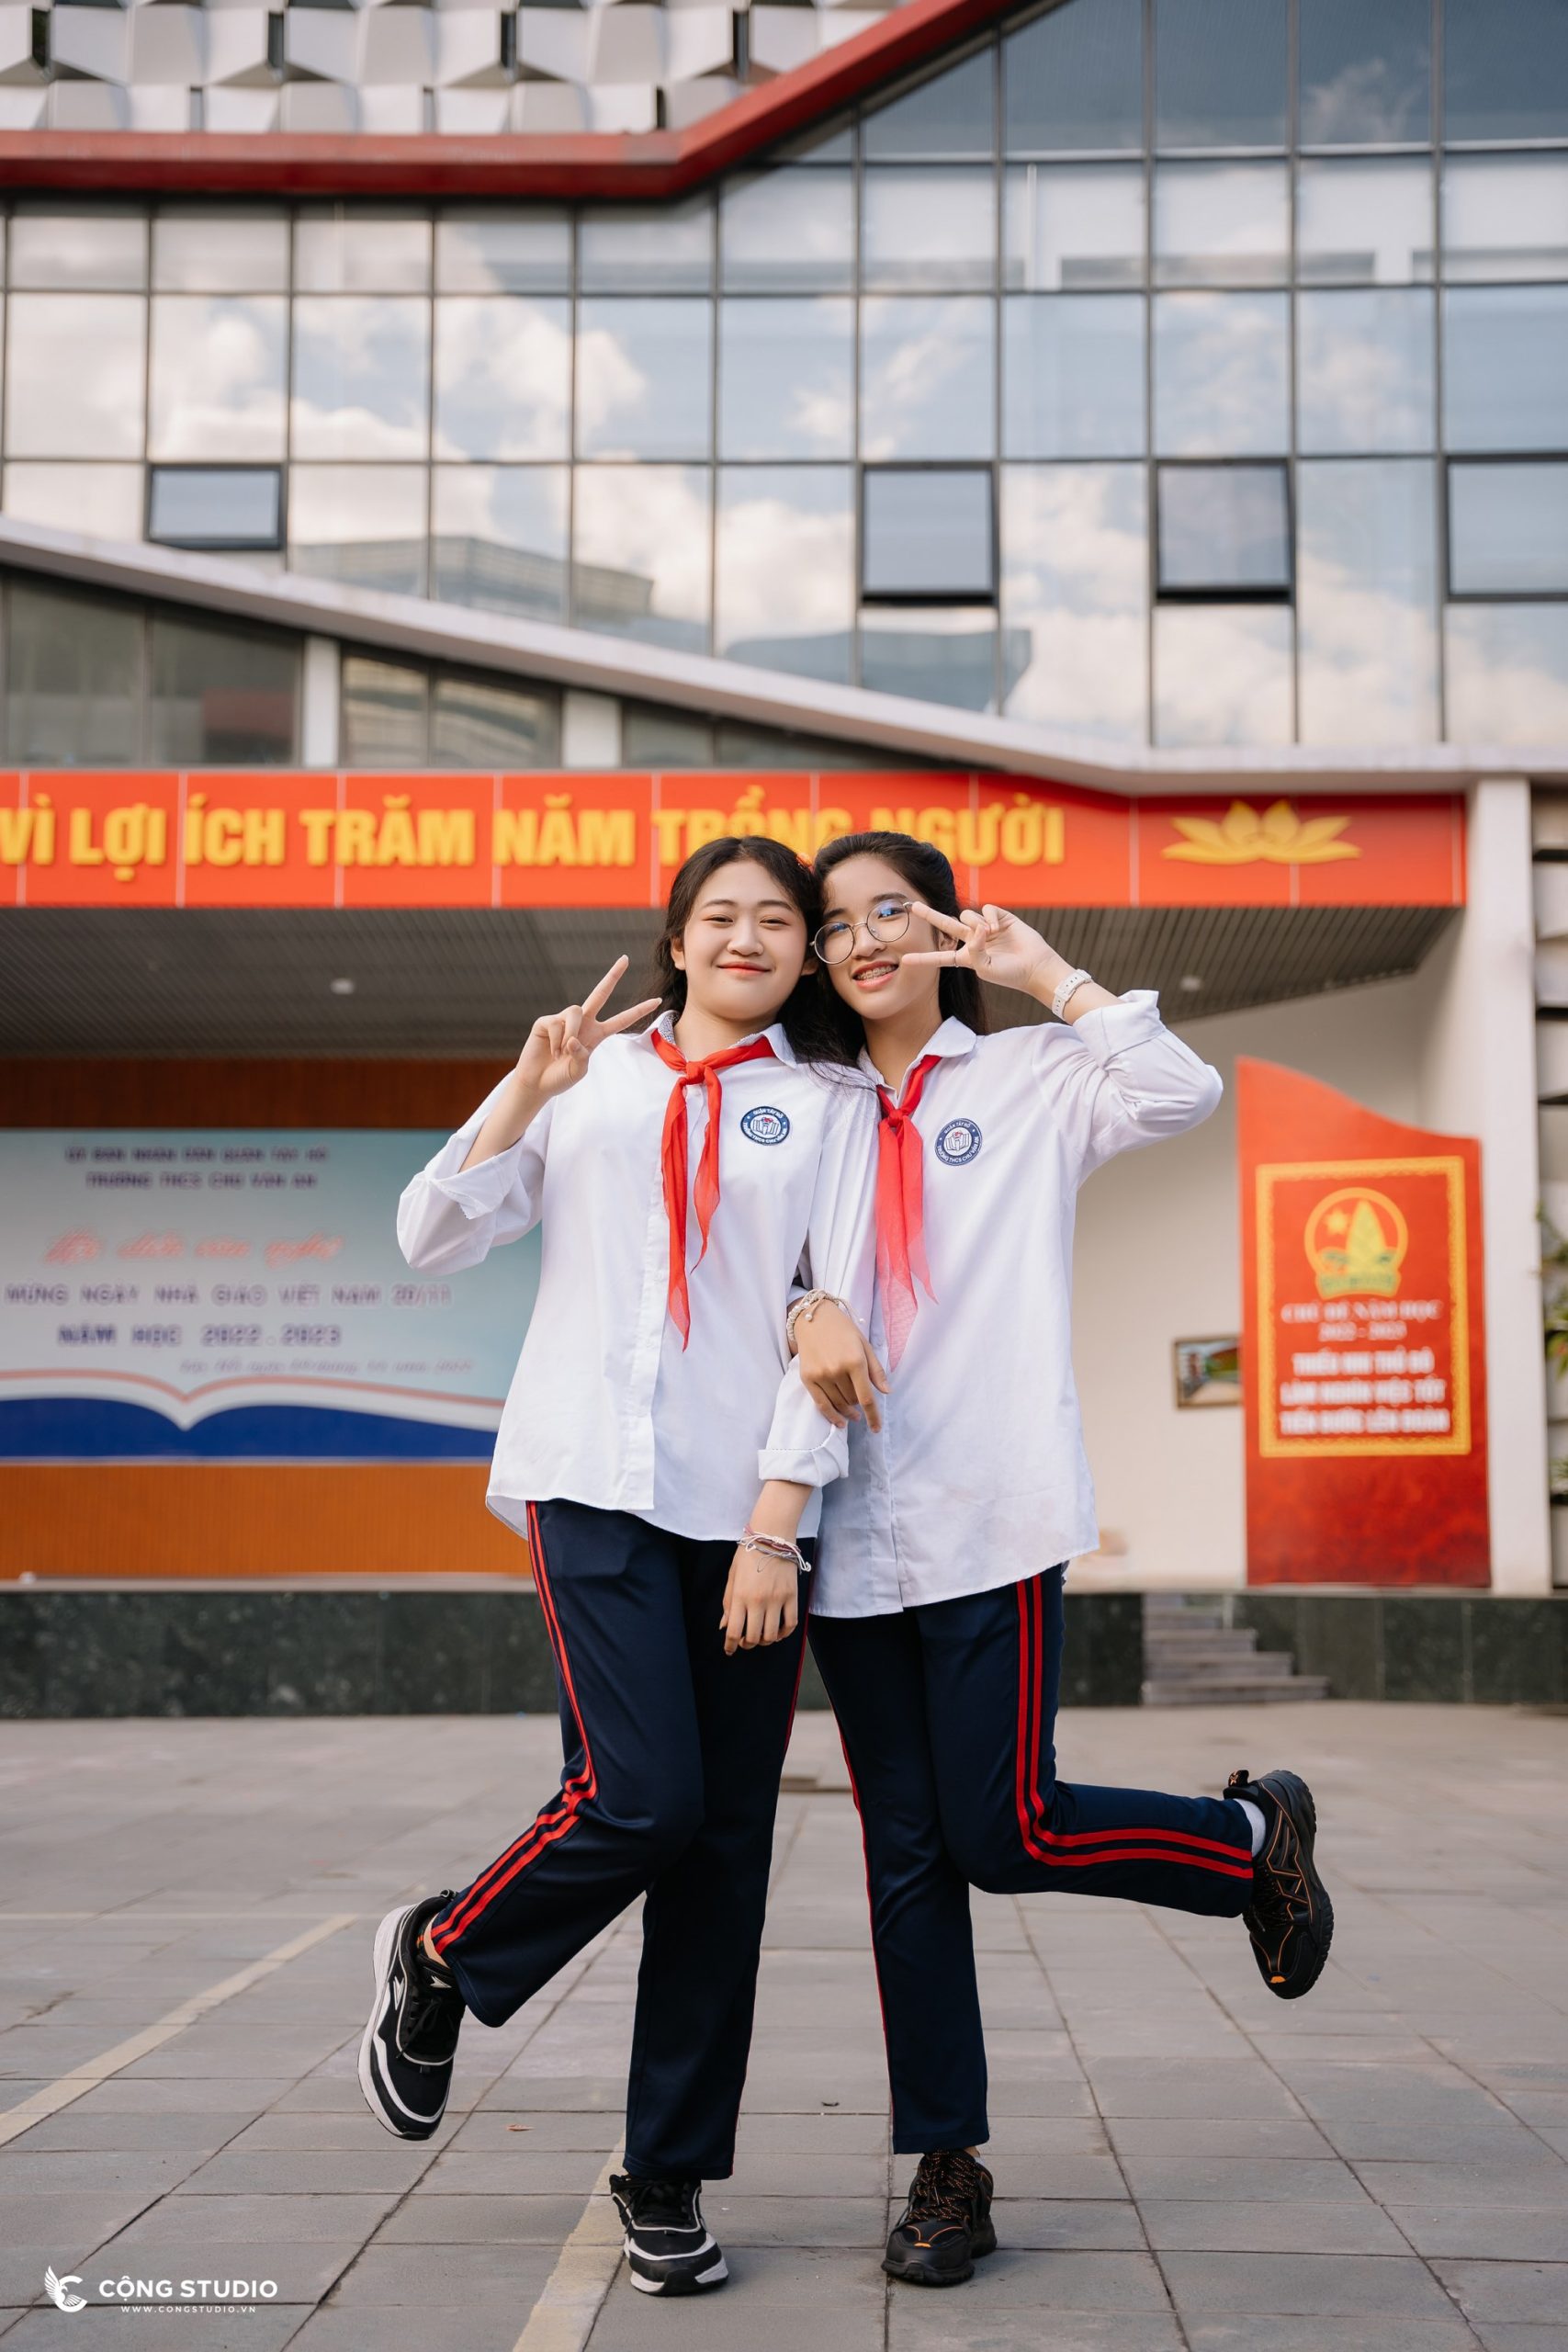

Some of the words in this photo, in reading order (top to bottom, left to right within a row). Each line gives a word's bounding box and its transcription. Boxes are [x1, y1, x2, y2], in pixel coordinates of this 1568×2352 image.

[0, 792, 55, 865] VÌ
[69, 802, 167, 883] LỢI
[184, 792, 286, 866] ÍCH
[299, 793, 476, 866] TRĂM
[491, 793, 636, 866] NĂM
